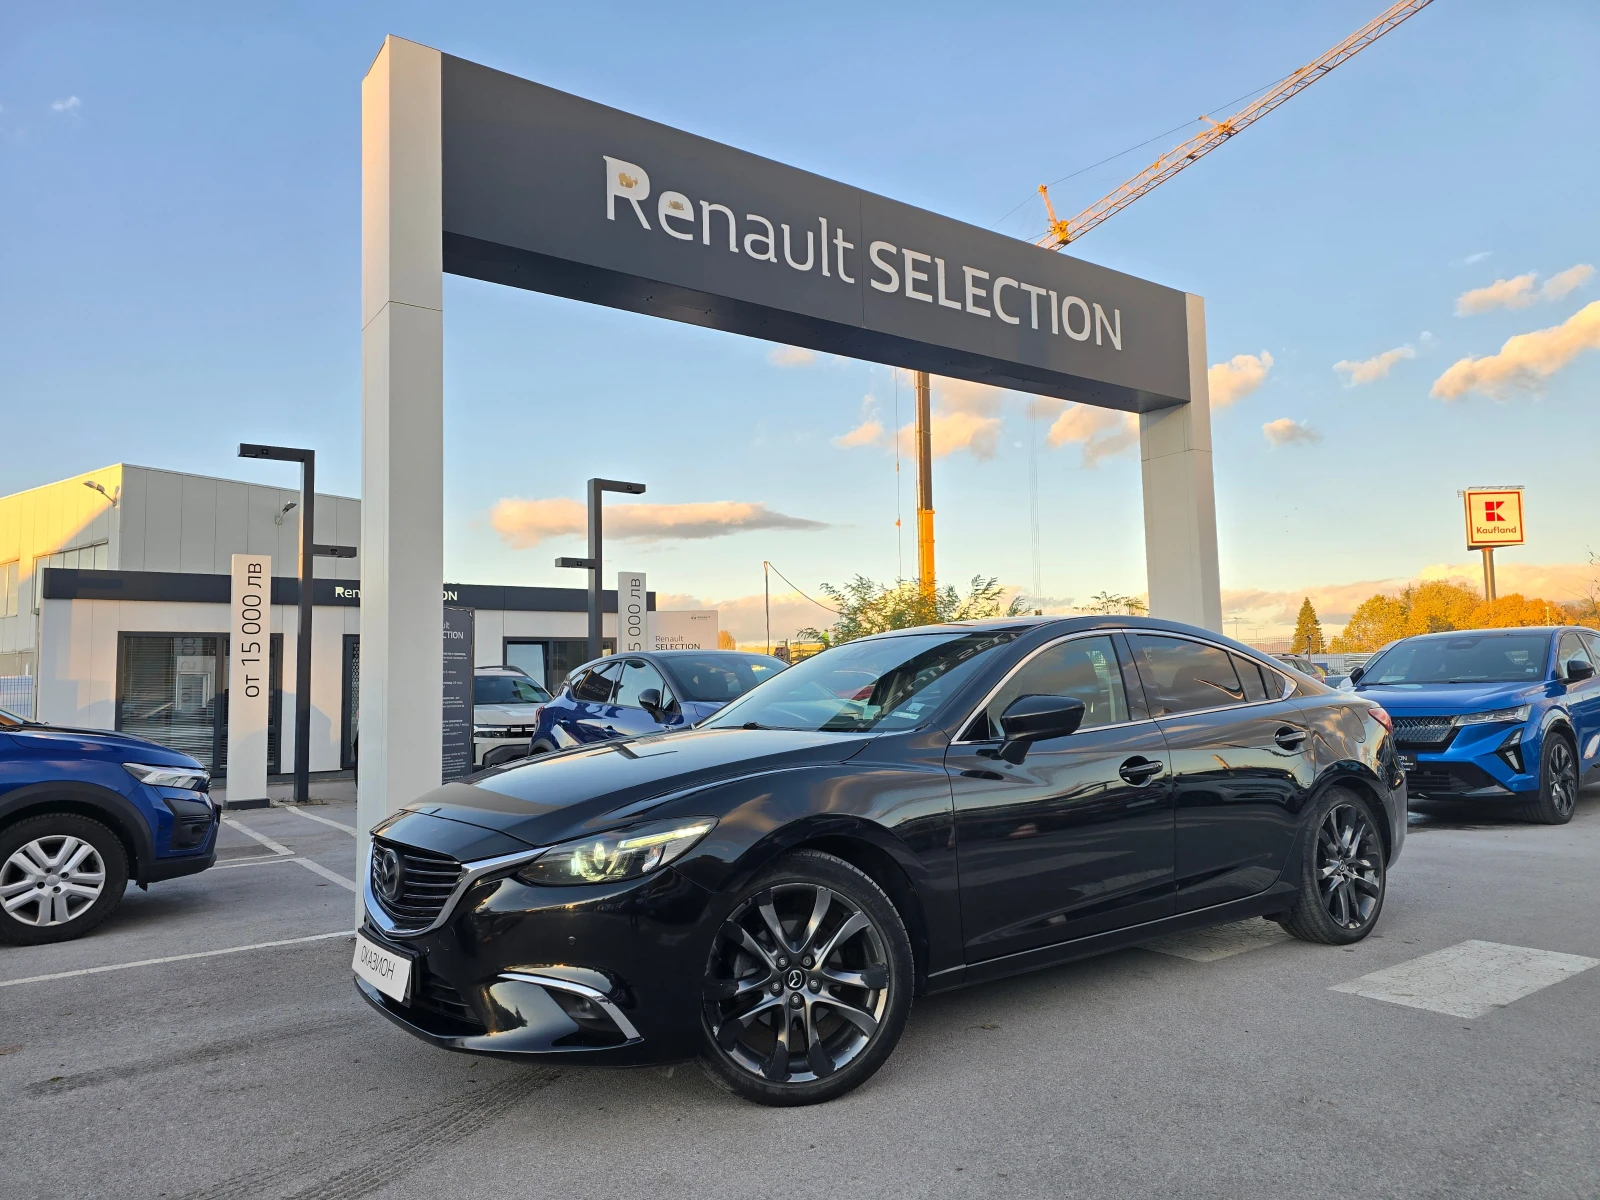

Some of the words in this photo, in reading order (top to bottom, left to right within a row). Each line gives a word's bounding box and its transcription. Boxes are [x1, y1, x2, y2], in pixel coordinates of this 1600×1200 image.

[602, 155, 855, 284] Renault
[870, 240, 1123, 351] SELECTION
[1477, 526, 1516, 534] Kaufland
[242, 595, 261, 635] 000
[628, 604, 641, 636] 000
[655, 635, 684, 643] Renault
[655, 643, 700, 651] SELECTION
[241, 642, 260, 666] 15
